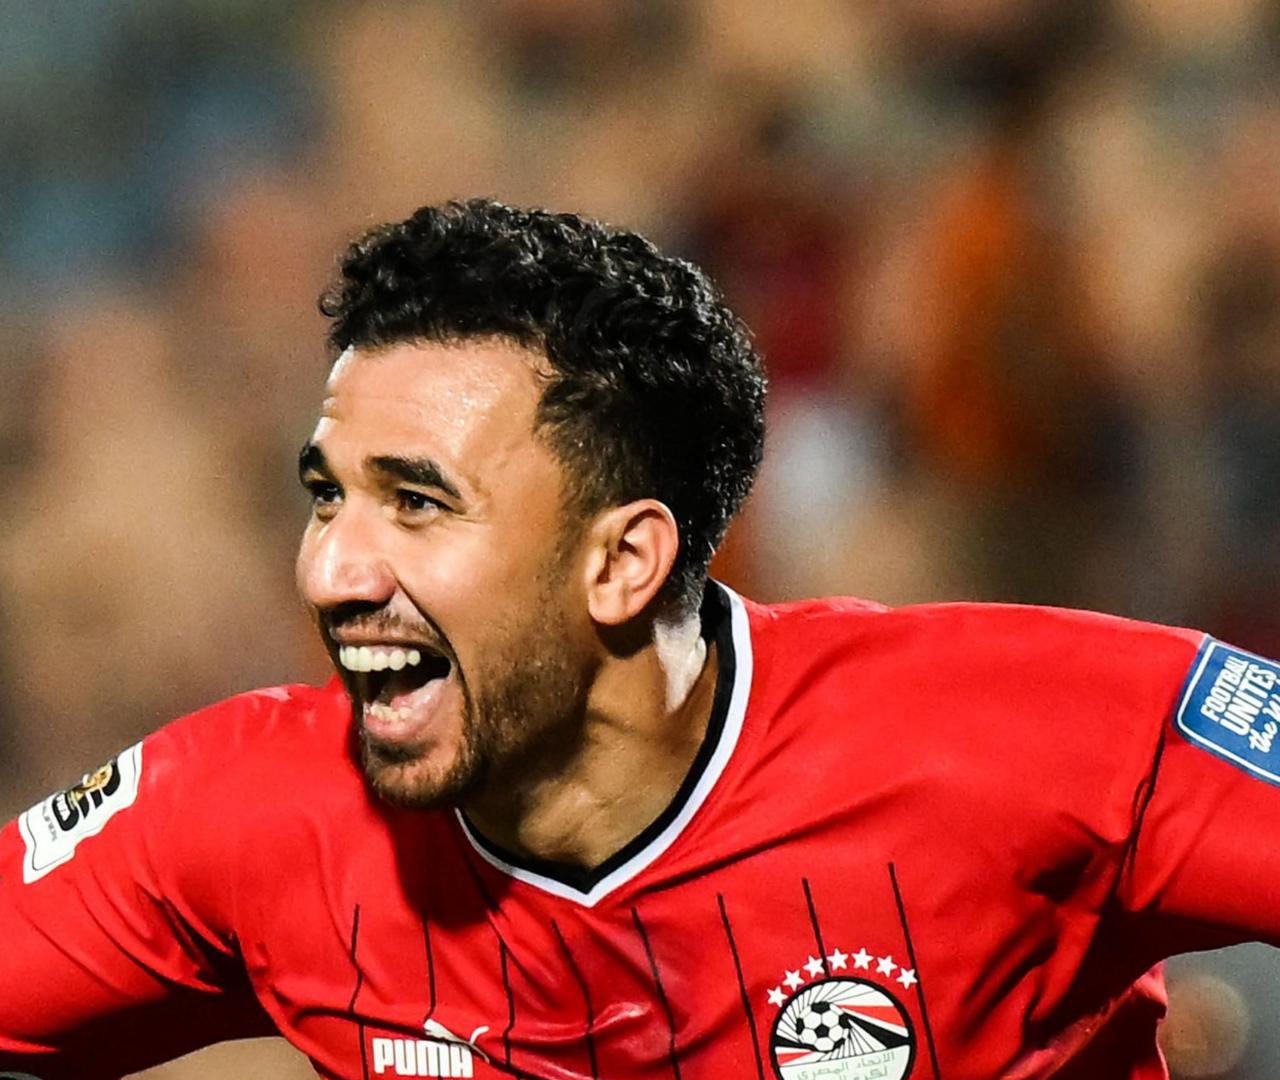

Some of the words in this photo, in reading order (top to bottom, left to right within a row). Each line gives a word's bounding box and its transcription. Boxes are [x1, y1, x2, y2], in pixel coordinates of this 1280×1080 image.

[1200, 655, 1248, 722] FOOTBALL
[1220, 664, 1277, 736] UNITES
[1248, 721, 1279, 753] the
[372, 1037, 474, 1078] PUMA
